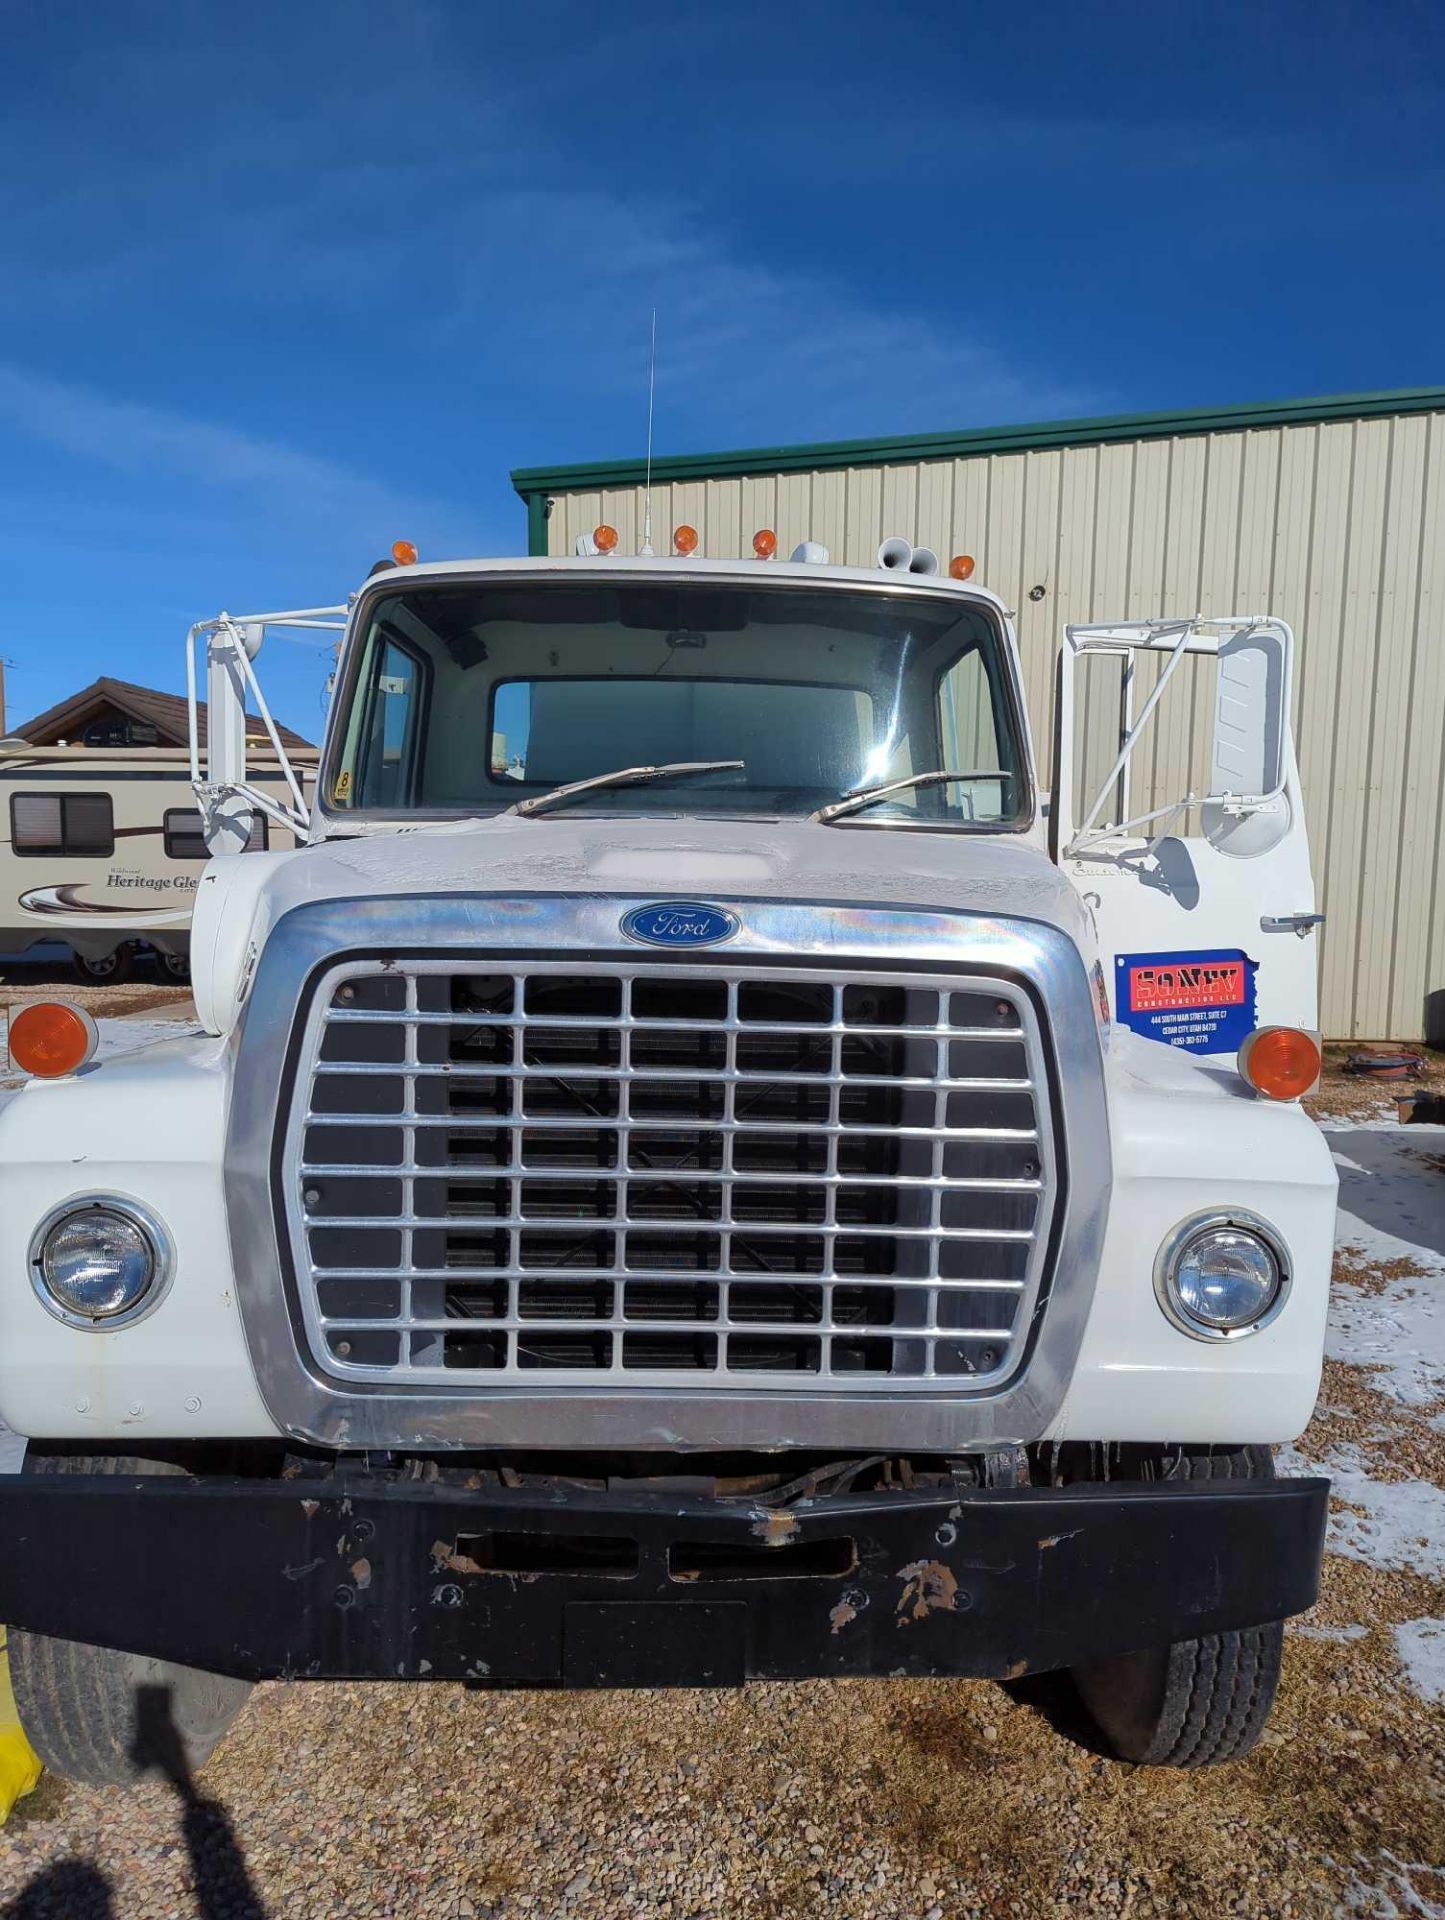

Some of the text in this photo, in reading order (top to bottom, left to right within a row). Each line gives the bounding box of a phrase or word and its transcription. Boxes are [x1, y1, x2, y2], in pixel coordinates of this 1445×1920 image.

[342, 772, 349, 787] 8
[106, 874, 171, 891] Heritage
[652, 911, 710, 936] Ford
[1219, 993, 1237, 1001] LLC
[1151, 1016, 1162, 1025] 444
[1162, 1014, 1177, 1024] SOUTH
[1177, 1013, 1190, 1022] MAIN
[1162, 1026, 1178, 1035] CEDAR
